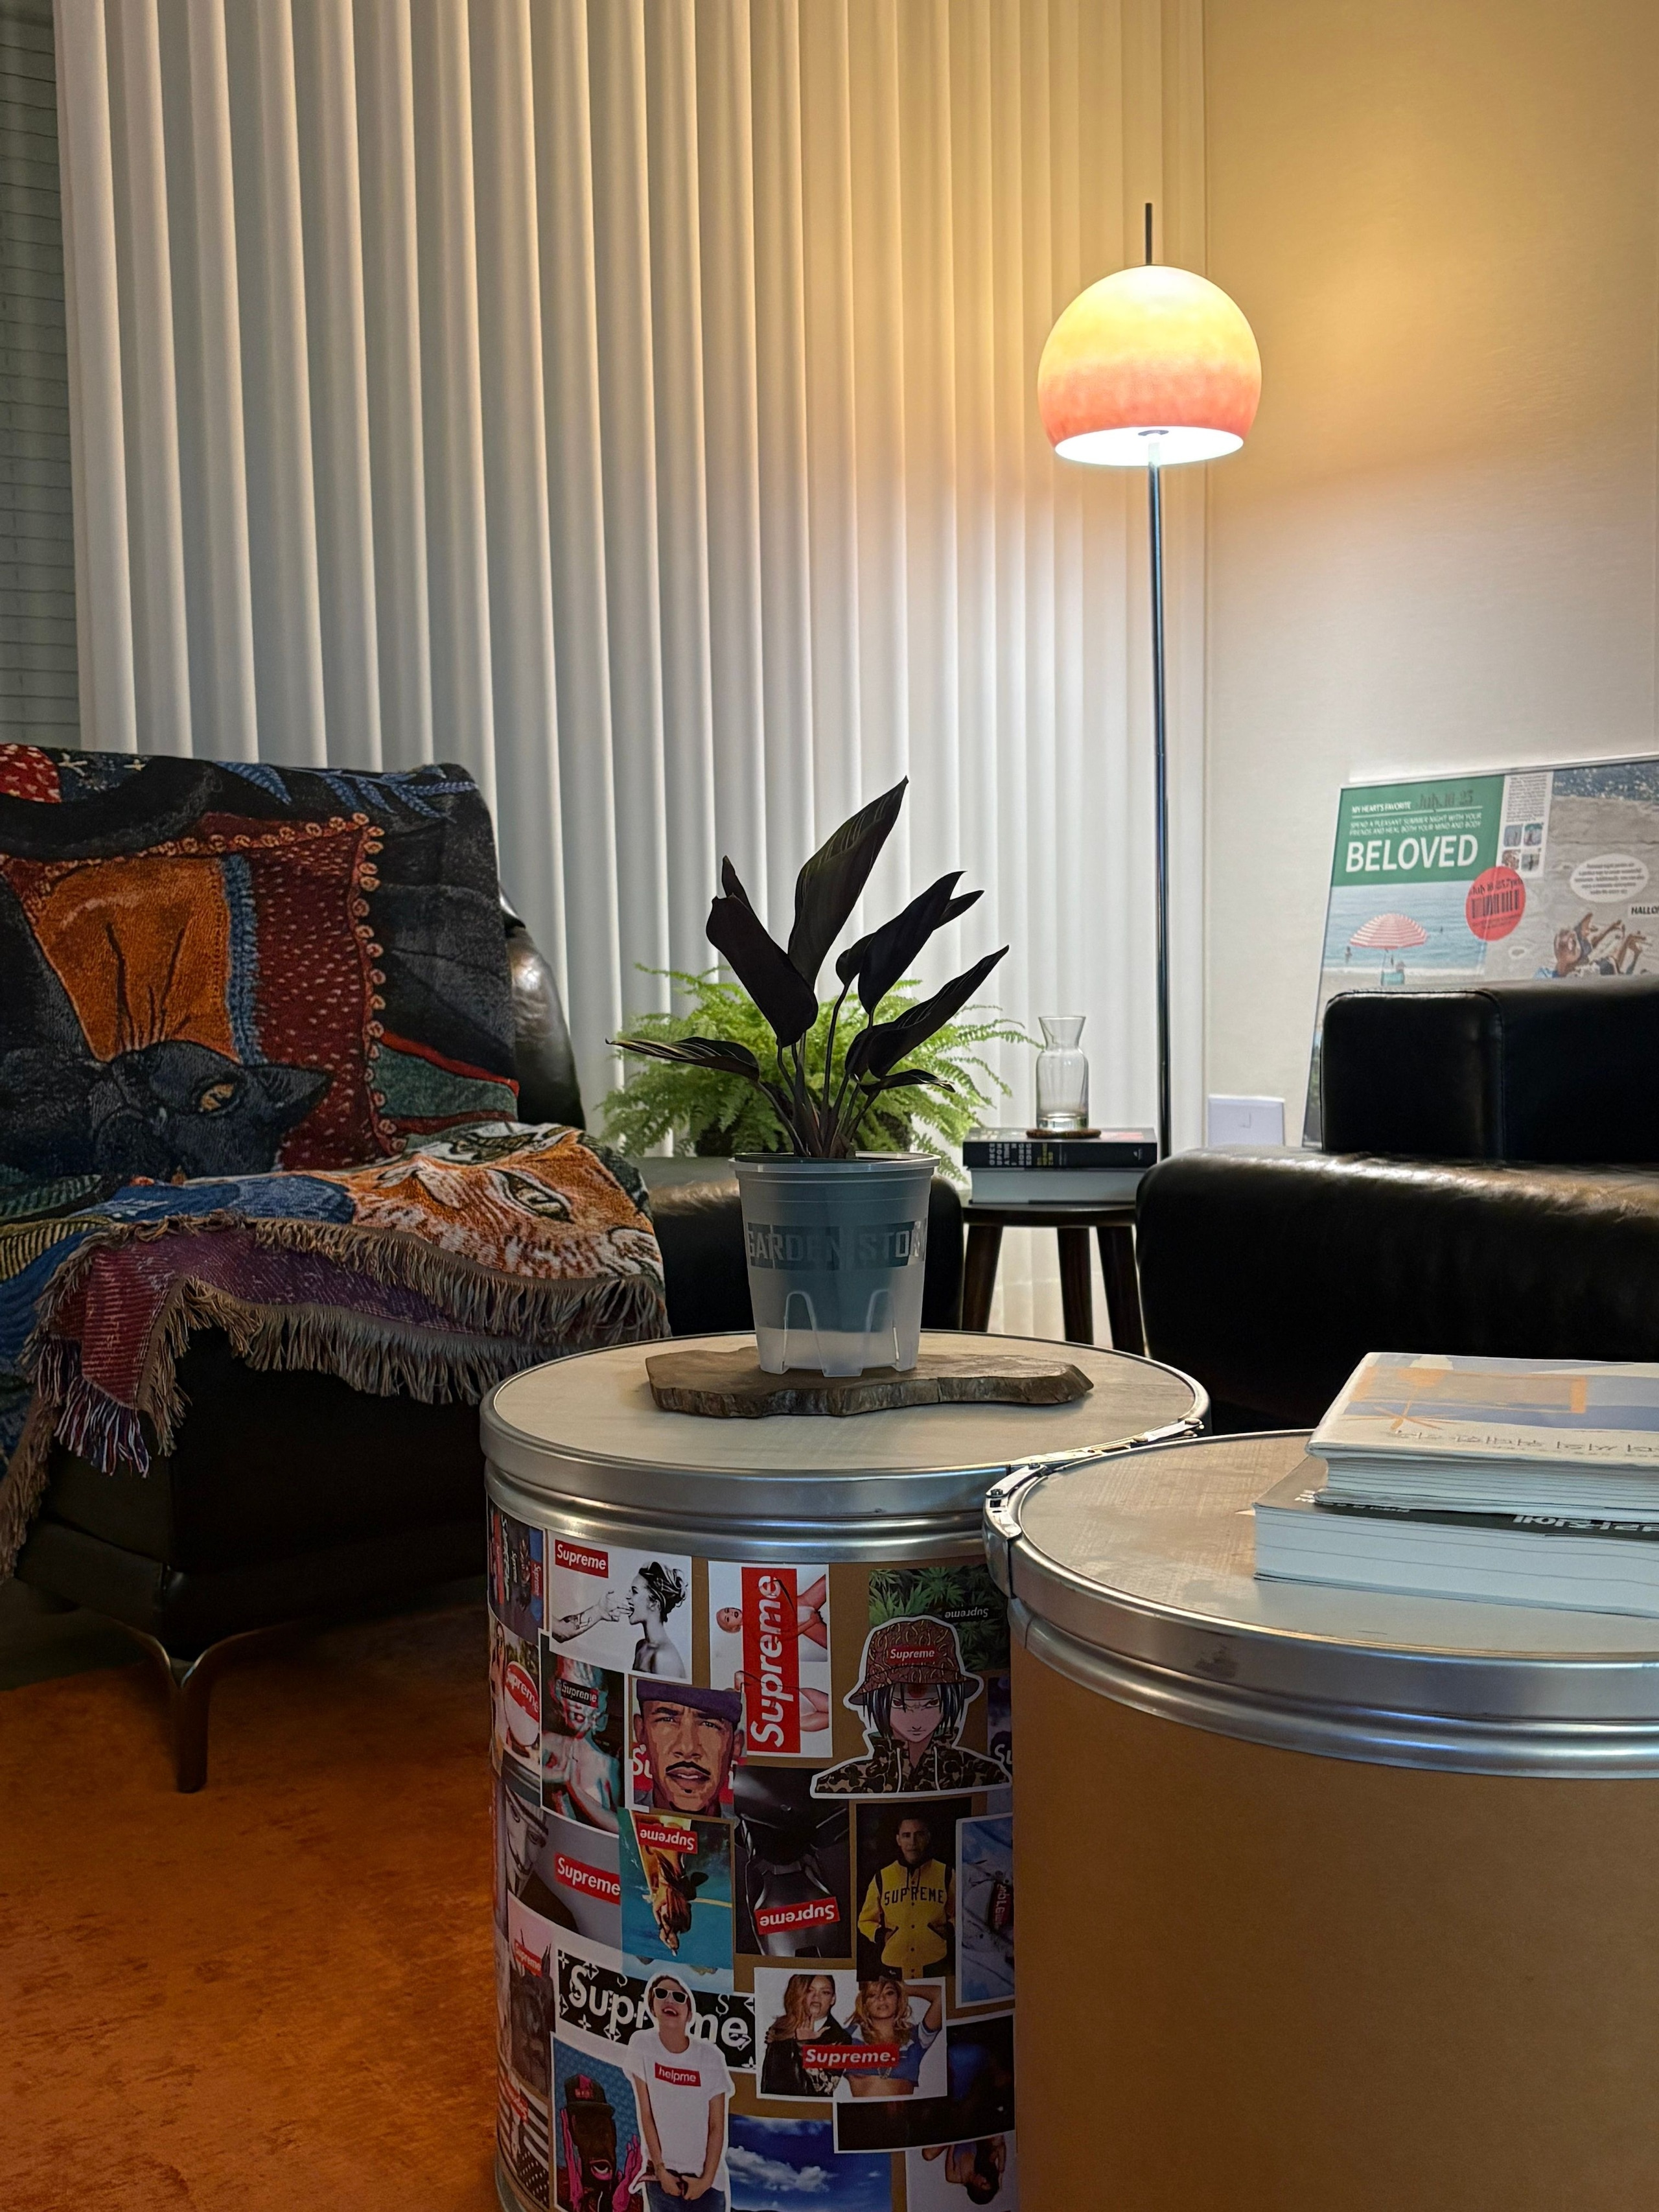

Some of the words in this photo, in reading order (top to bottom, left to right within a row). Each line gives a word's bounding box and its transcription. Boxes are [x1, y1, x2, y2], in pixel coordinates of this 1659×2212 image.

[1345, 834, 1479, 873] BELOVED
[556, 1543, 607, 1570] Supreme
[531, 1563, 541, 1596] Supreme
[944, 1606, 990, 1618] Supreme
[750, 1575, 795, 1748] Supreme
[890, 1648, 935, 1662] Supreme
[561, 1683, 597, 1703] Supreme
[640, 1828, 696, 1851] Supreme
[557, 1857, 621, 1896] Supreme
[883, 1886, 945, 1905] SUPREME
[760, 1903, 835, 1927] Supreme
[569, 1964, 748, 2049] Suprme
[805, 2048, 897, 2067] Supreme.
[658, 2066, 697, 2084] helpme
